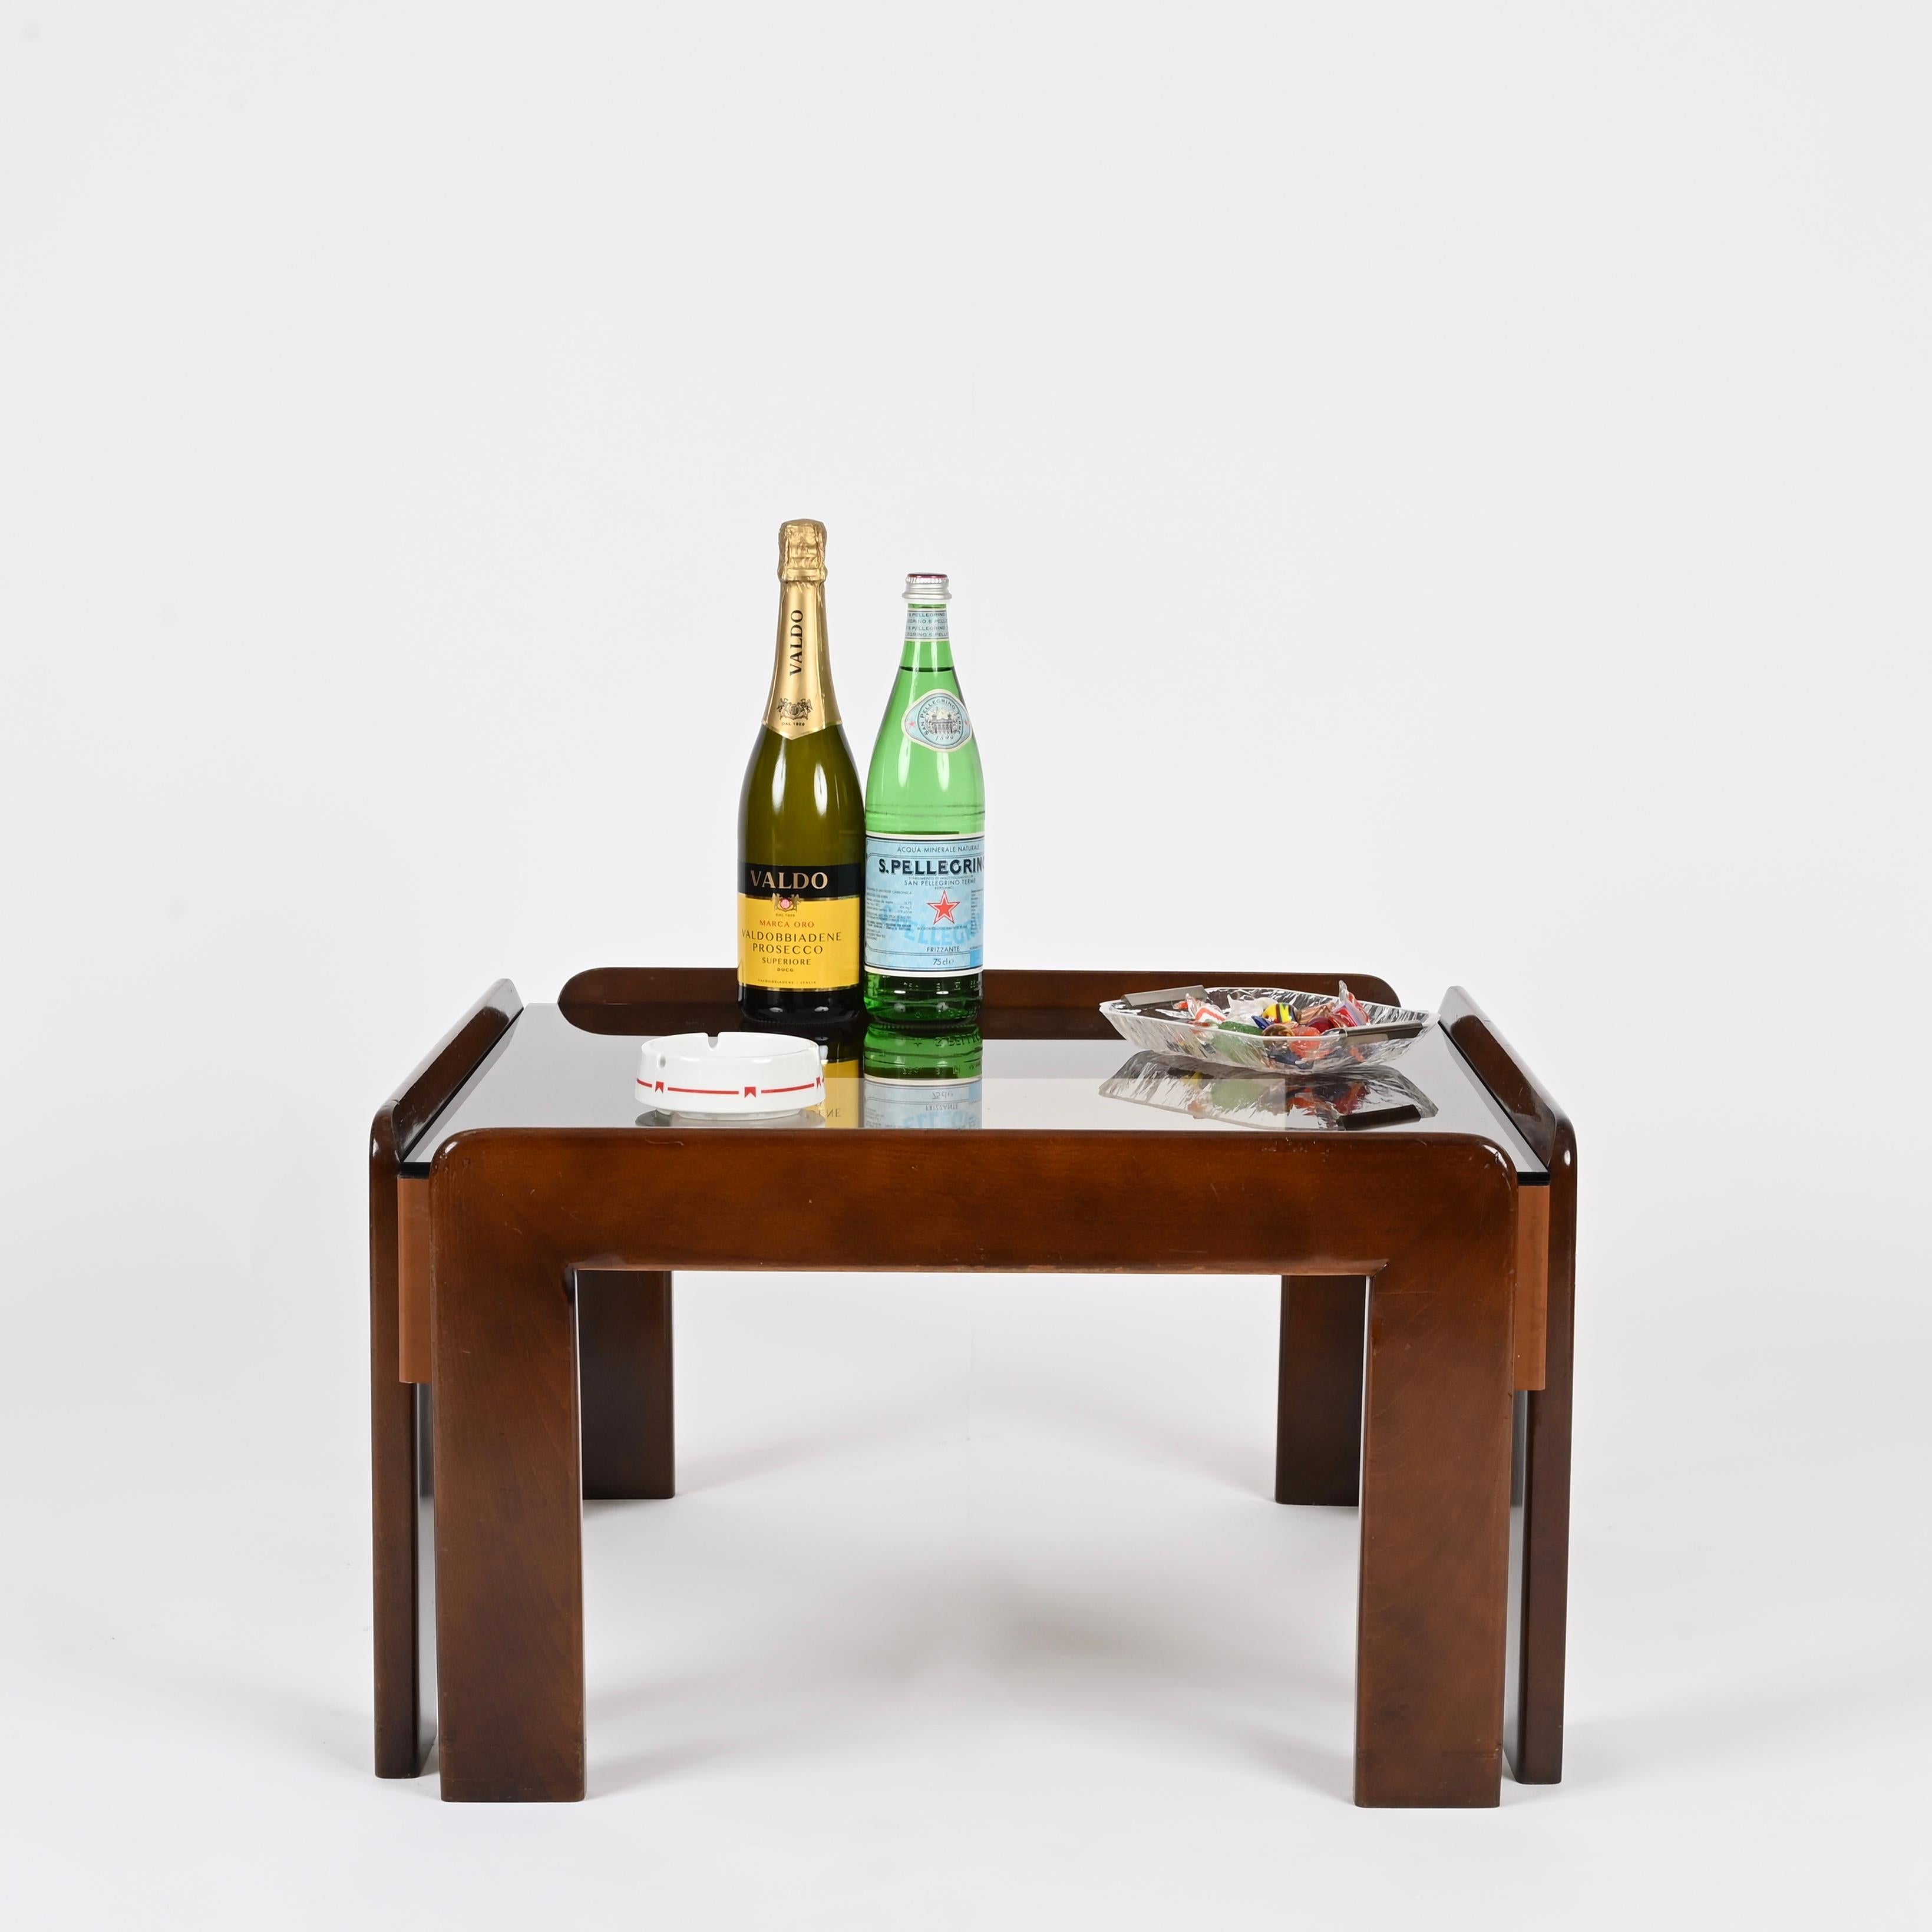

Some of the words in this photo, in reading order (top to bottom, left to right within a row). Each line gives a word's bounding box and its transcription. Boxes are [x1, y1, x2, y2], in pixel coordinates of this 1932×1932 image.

[790, 609, 803, 676] VALDO
[920, 699, 956, 719] PELLEGRINO
[750, 870, 828, 889] VALDO
[741, 929, 842, 942] VALDOBBIADENE
[752, 943, 824, 955] PROSECCO
[762, 957, 811, 966] SUPERIORE
